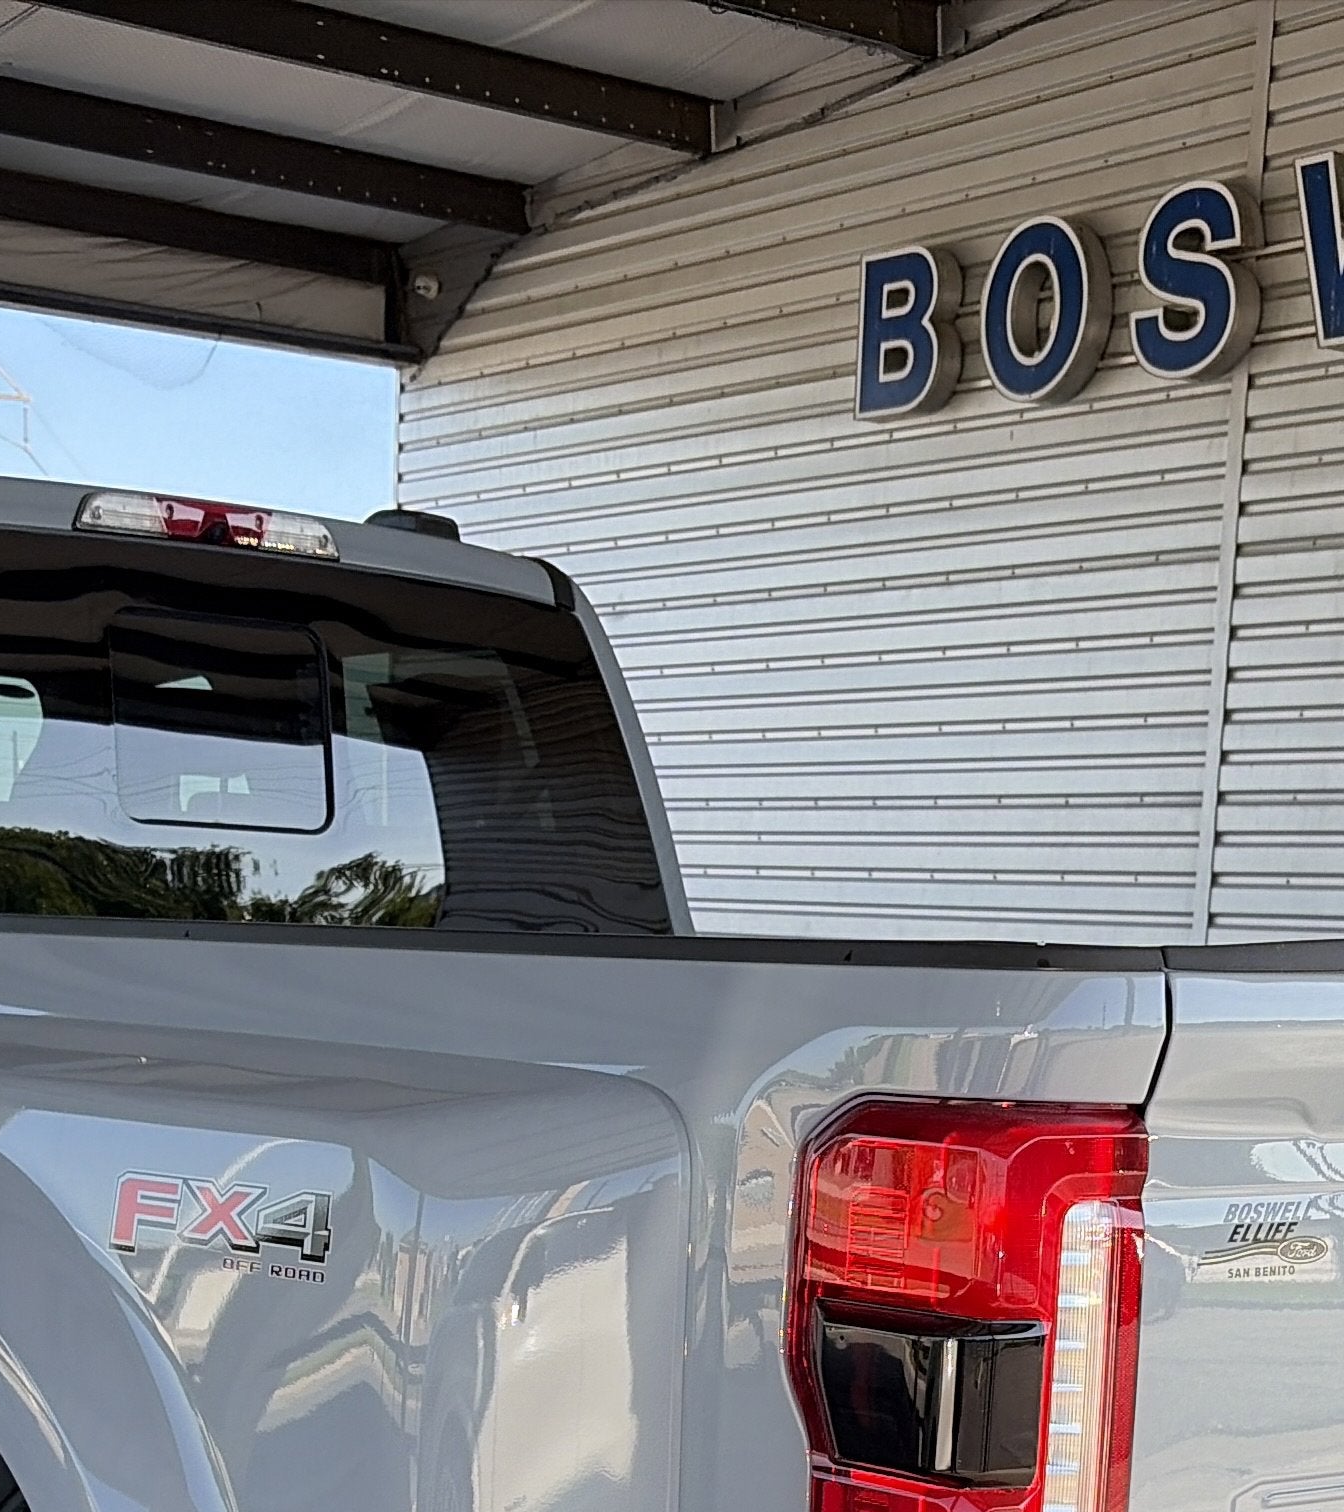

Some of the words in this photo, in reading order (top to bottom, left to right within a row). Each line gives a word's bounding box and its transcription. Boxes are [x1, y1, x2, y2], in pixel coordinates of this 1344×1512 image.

[108, 1168, 334, 1266] FX4
[1223, 1200, 1313, 1223] BOSWELL
[1227, 1221, 1299, 1243] ELLIFF
[1288, 1241, 1317, 1258] Ford
[222, 1258, 262, 1274] OFF
[269, 1265, 326, 1284] ROAD
[1227, 1267, 1250, 1279] SAN
[1254, 1265, 1296, 1277] BENITO
